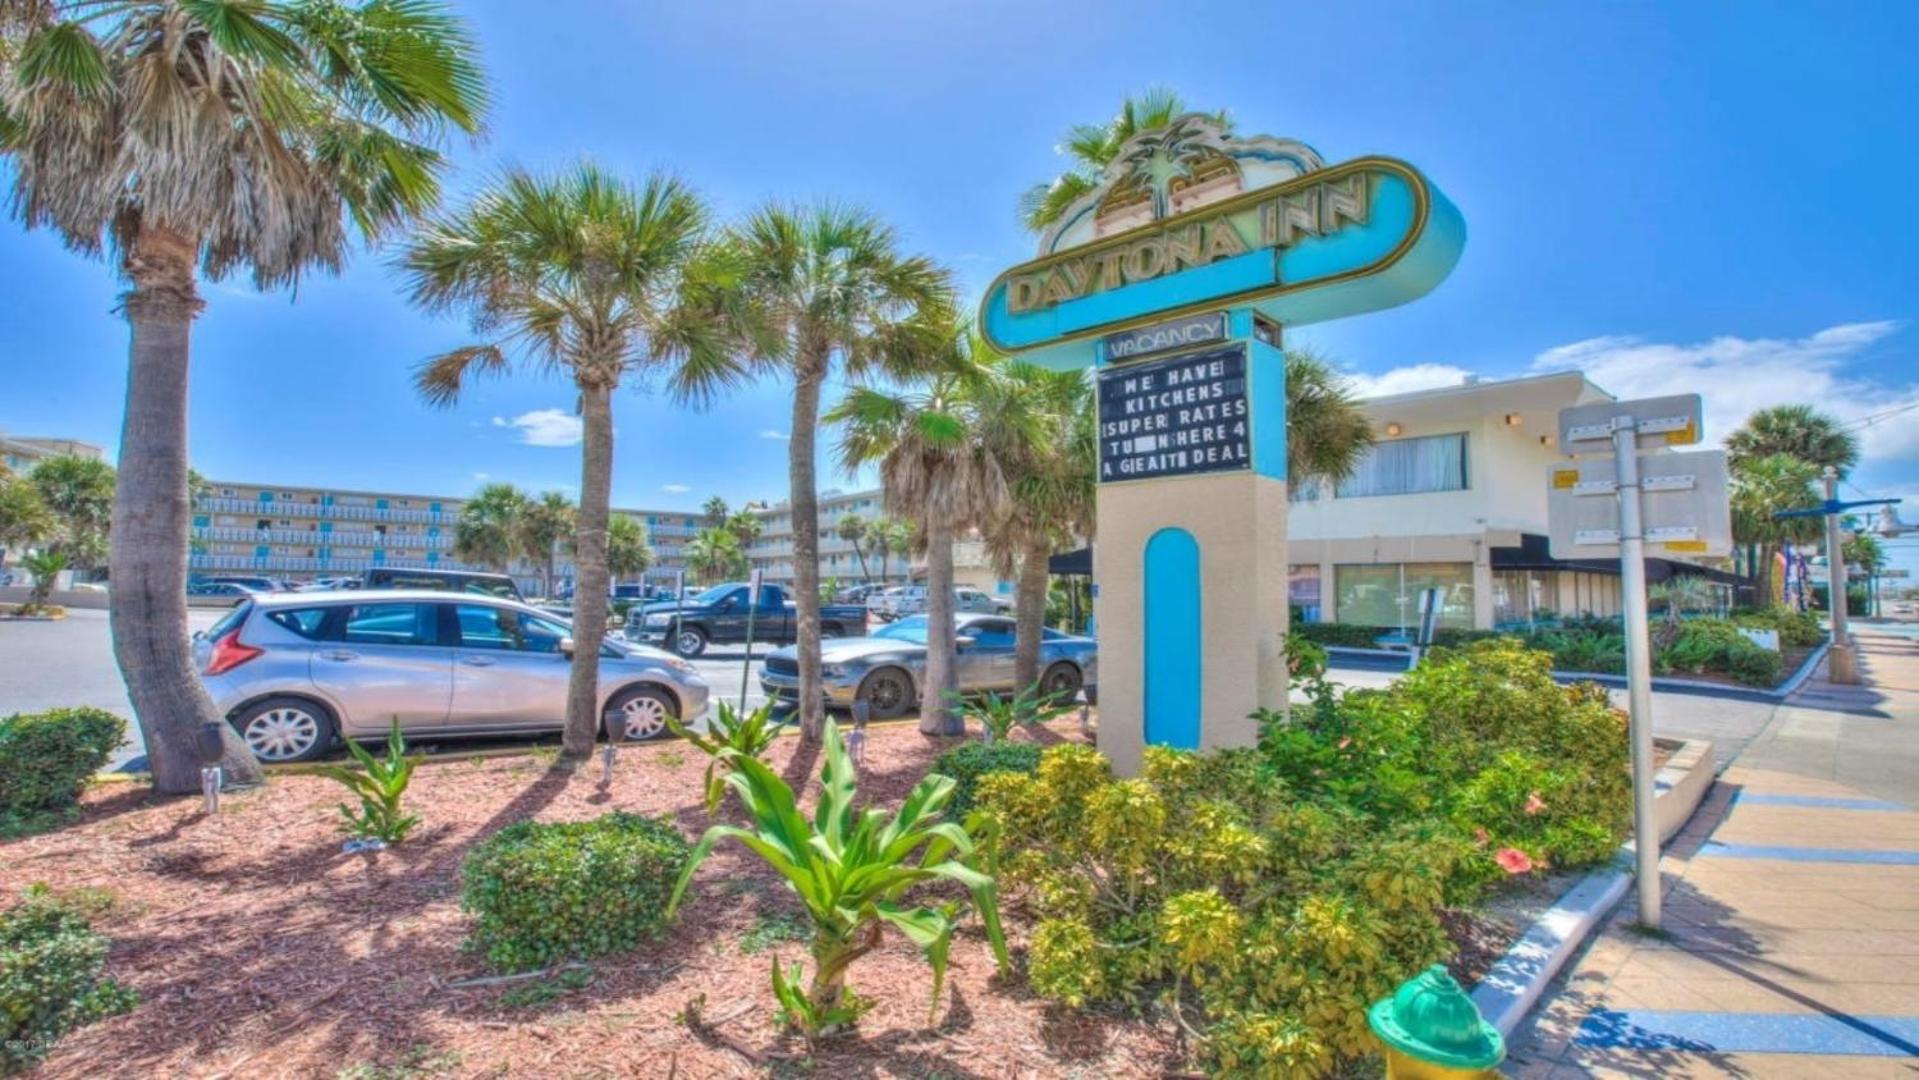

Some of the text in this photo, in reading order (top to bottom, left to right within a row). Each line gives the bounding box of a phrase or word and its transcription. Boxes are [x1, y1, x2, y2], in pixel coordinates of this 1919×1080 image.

[1008, 171, 1367, 315] DAYTONA INN
[1111, 320, 1221, 357] VACANCY
[1125, 361, 1222, 394] WE HAVE
[1126, 382, 1223, 414] KITCHENS
[1108, 400, 1246, 437] SUPER RATES
[1177, 425, 1226, 446] HERE
[1233, 421, 1245, 437] 4
[1103, 462, 1113, 476] A
[1193, 443, 1247, 464] DEAL
